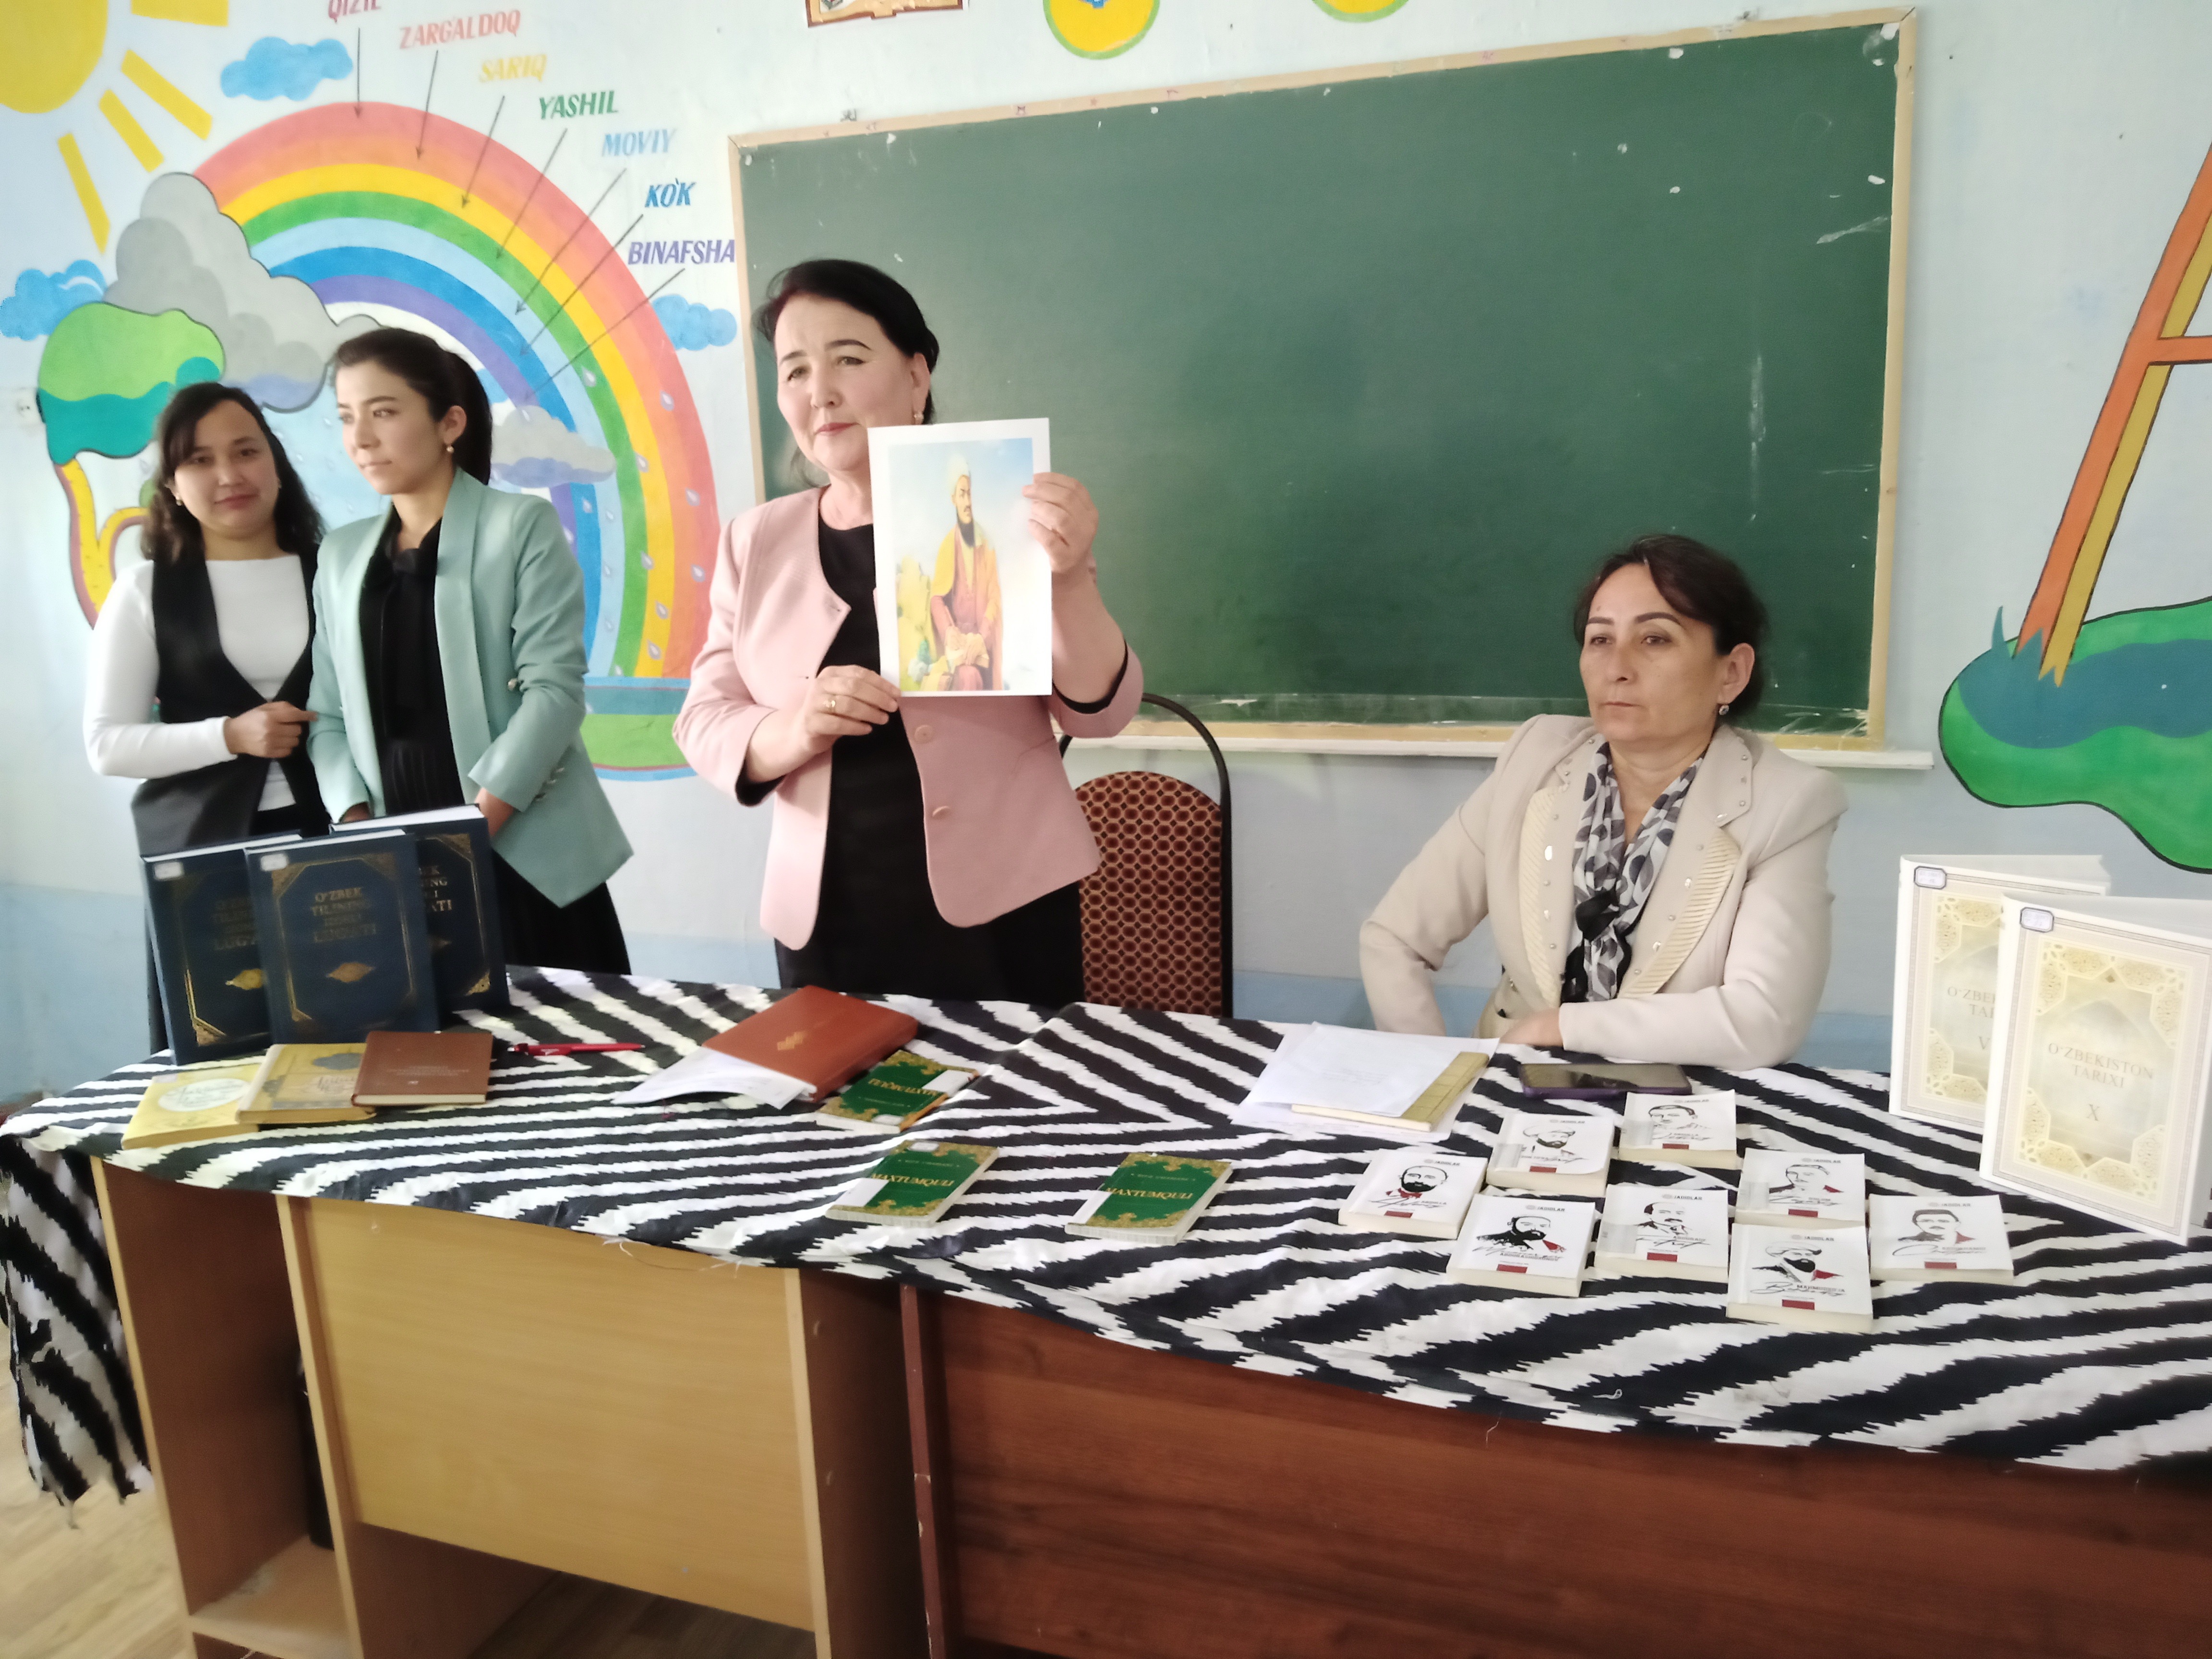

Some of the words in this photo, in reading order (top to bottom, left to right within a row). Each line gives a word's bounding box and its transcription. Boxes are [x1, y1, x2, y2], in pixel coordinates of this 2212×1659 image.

[480, 53, 547, 83] SARIQ
[539, 90, 620, 120] YASHIL
[601, 128, 677, 157] MOVIY
[627, 239, 736, 265] BINAFSHA
[2072, 1064, 2125, 1088] TARIXI
[2086, 1104, 2101, 1121] X
[871, 1173, 955, 1187] MAXTUMQULI
[1106, 1187, 1194, 1200] MAXTUMQULI
